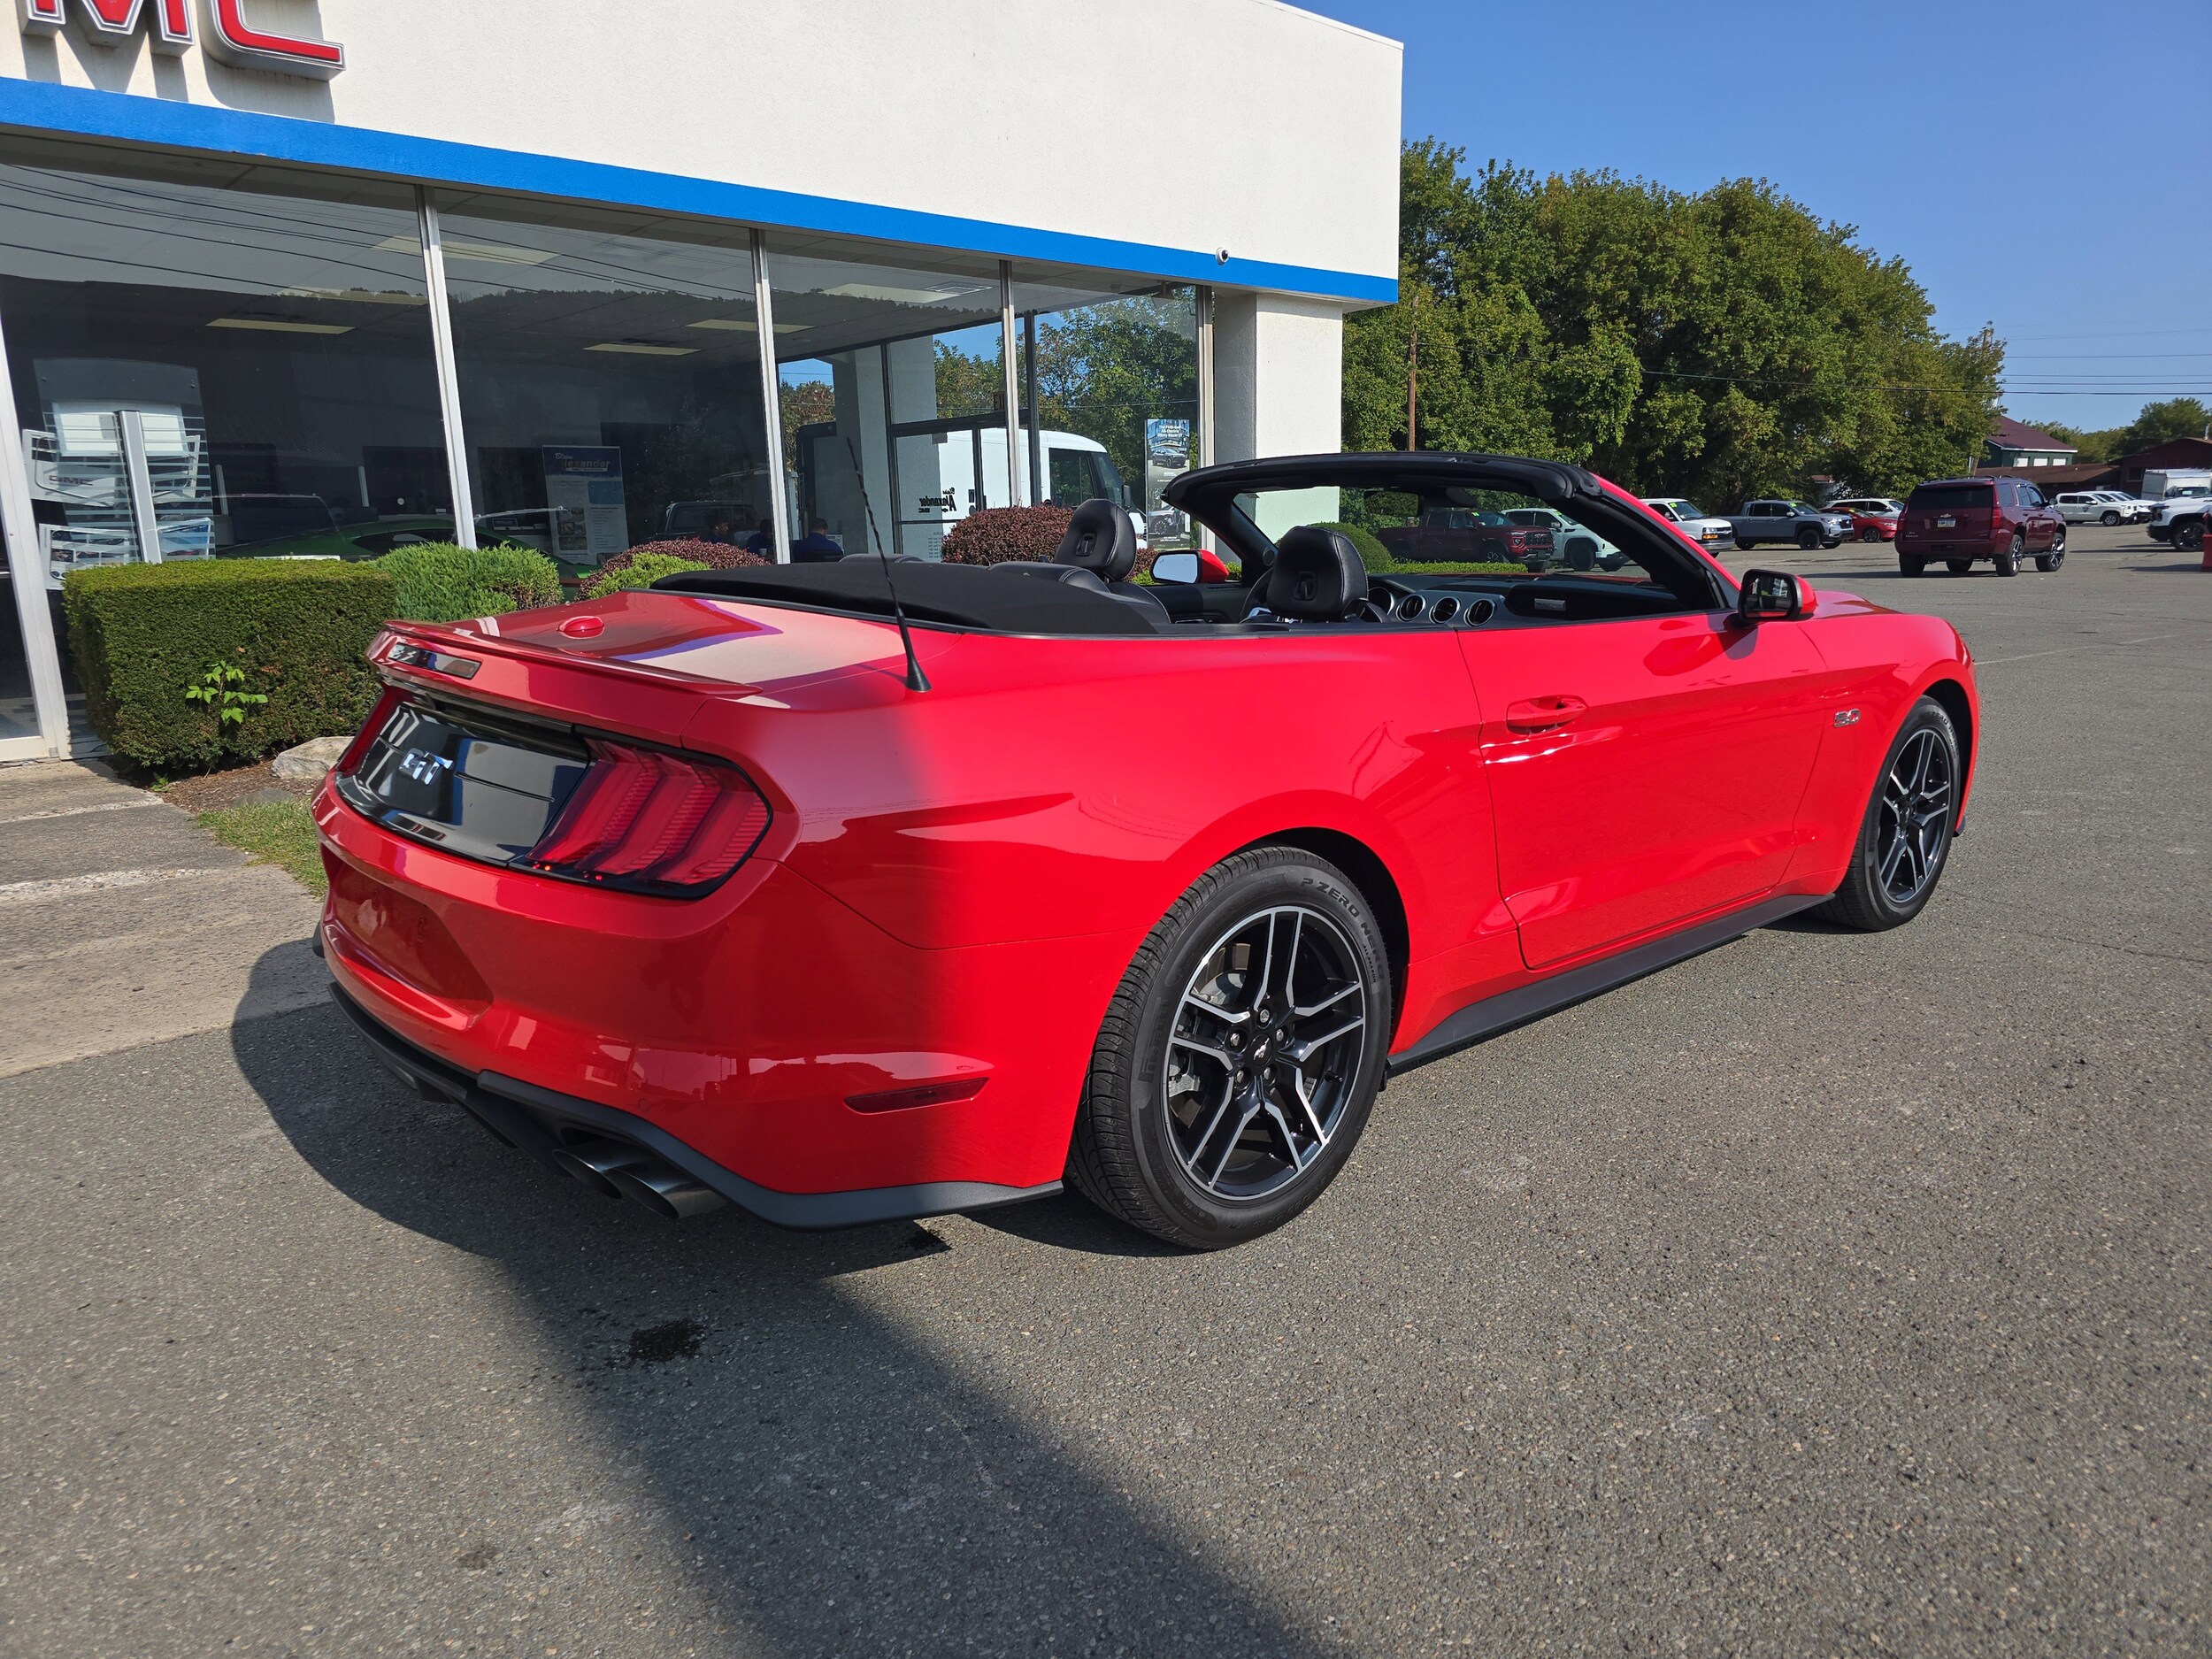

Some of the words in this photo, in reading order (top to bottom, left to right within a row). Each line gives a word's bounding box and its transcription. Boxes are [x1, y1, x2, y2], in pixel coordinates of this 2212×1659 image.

[993, 393, 1006, 411] EXI
[49, 475, 93, 486] GMC
[399, 748, 454, 786] GT
[1300, 878, 1314, 887] P
[1315, 881, 1360, 918] ZERO
[1360, 922, 1386, 979] NERO
